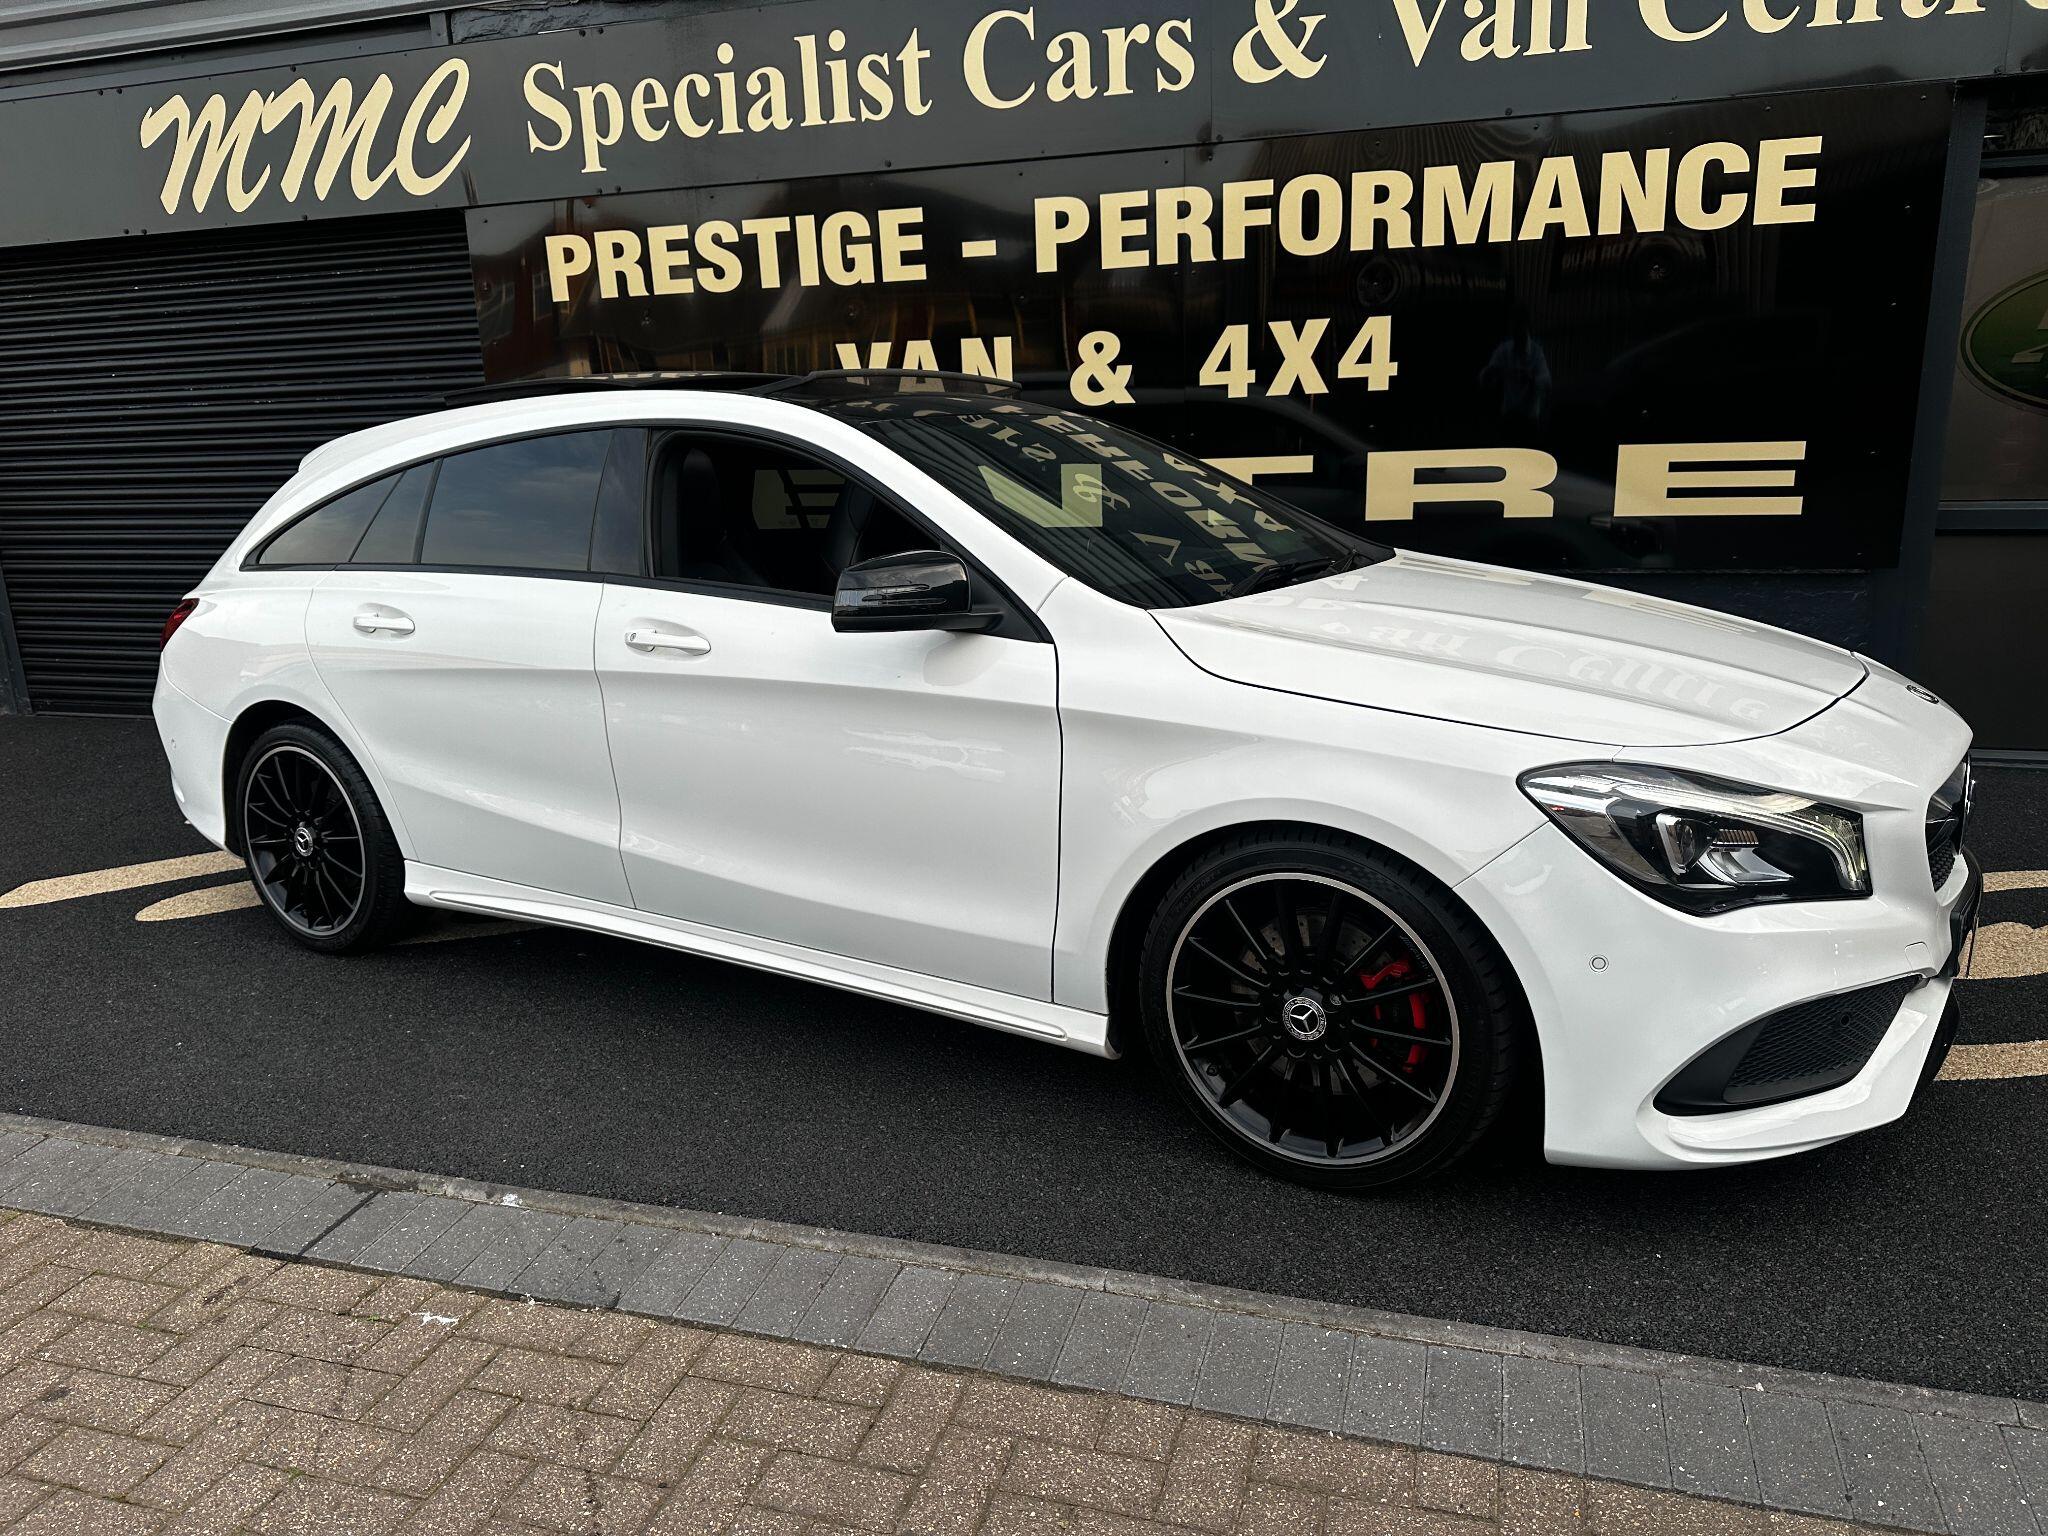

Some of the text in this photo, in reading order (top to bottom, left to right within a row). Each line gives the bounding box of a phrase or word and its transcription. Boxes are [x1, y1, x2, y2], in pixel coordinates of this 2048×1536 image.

[140, 57, 471, 214] MMC
[523, 29, 933, 174] Specialist
[963, 6, 1196, 109] Cars
[1232, 0, 1328, 84] &
[545, 206, 927, 303] PRESTIGE
[1034, 135, 1823, 273] PERFORMANCE
[1069, 330, 1135, 406] &
[1199, 315, 1399, 399] 4X4
